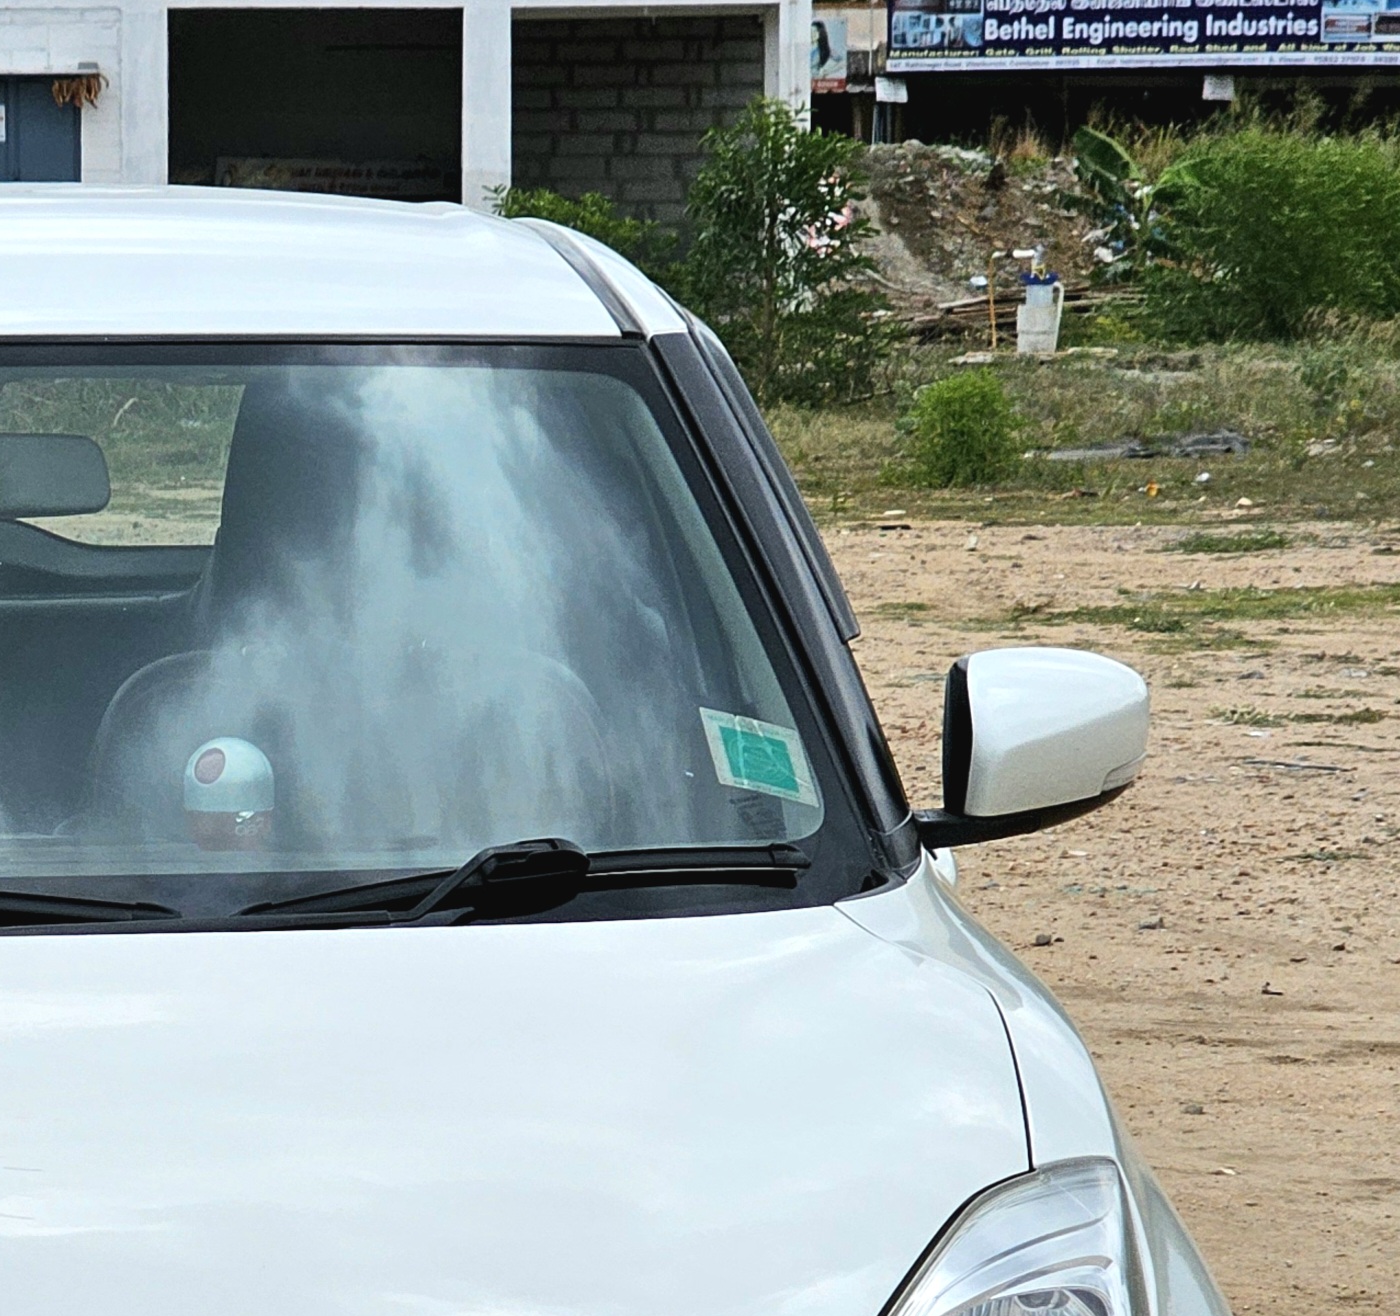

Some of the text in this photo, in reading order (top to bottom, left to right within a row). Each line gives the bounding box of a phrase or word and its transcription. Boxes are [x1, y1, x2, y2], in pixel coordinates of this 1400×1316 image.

[984, 11, 1319, 45] Bethel Engineering Industries
